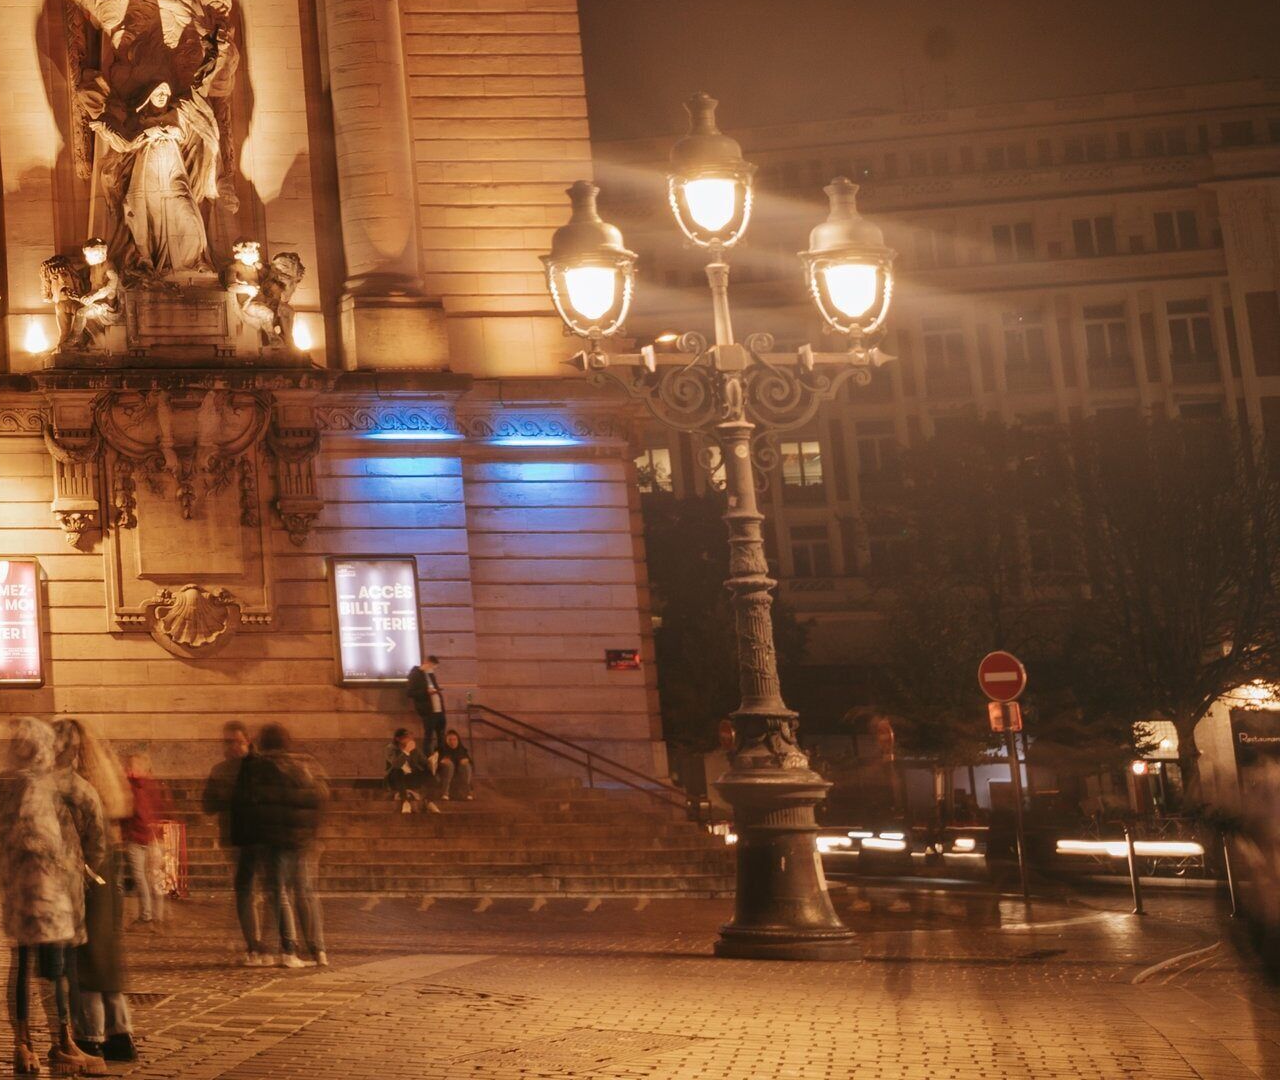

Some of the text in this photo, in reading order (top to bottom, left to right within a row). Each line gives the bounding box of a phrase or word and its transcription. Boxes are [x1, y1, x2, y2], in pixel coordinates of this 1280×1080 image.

[358, 582, 413, 599] ACCÈS
[339, 601, 391, 615] BILLET
[372, 617, 417, 631] TERIE
